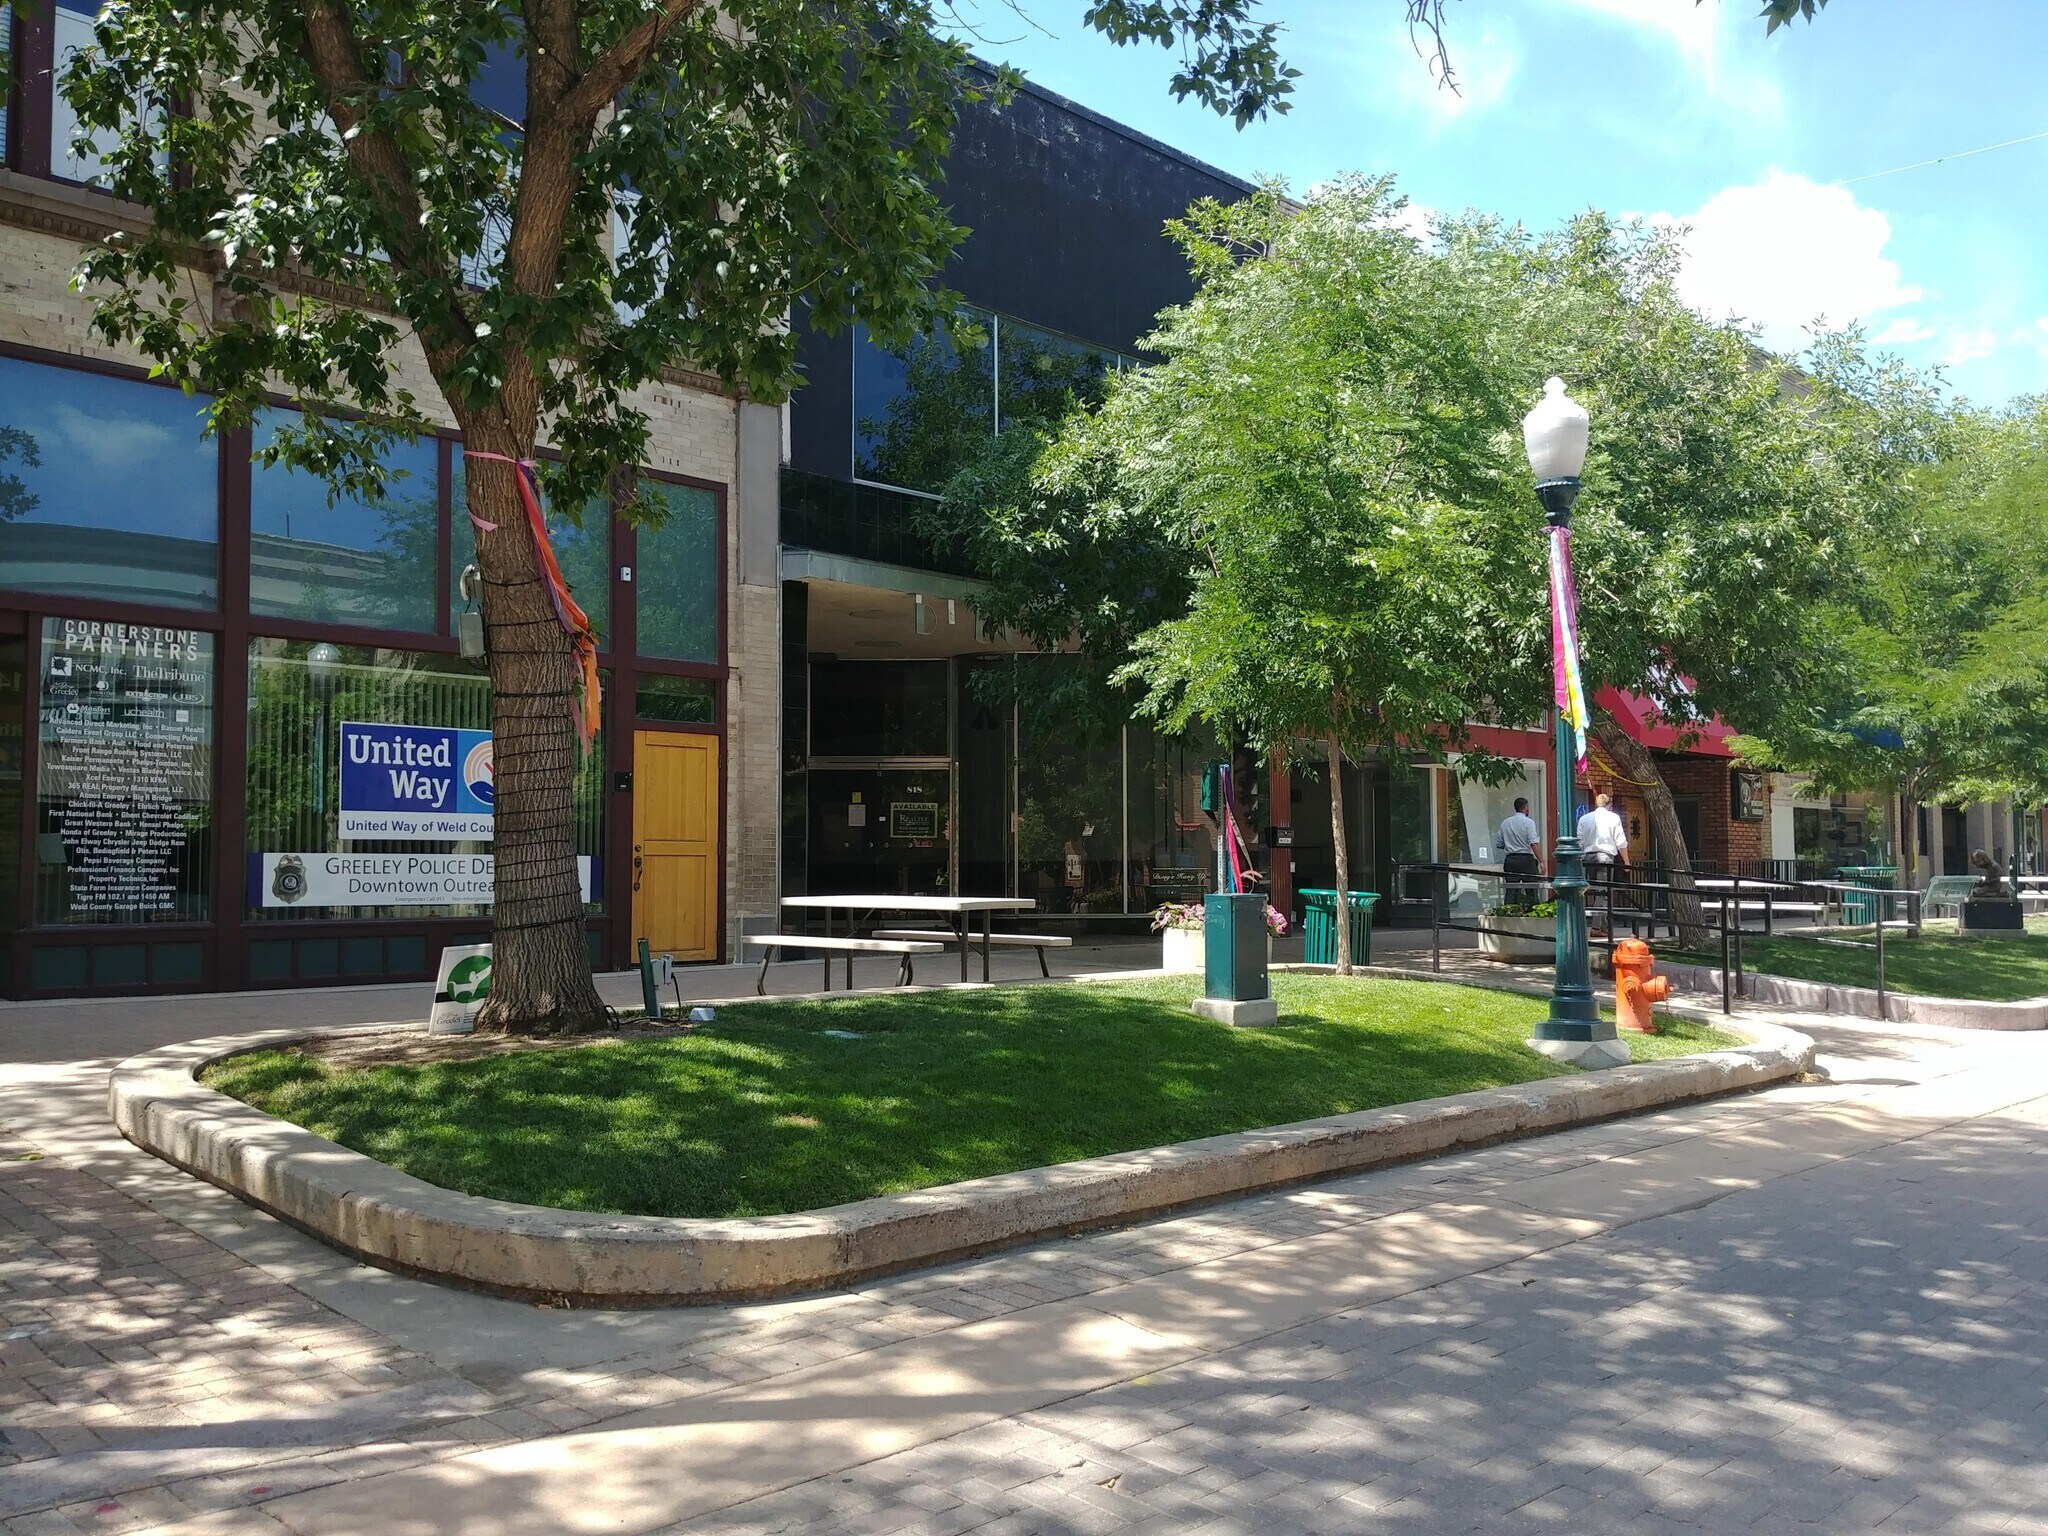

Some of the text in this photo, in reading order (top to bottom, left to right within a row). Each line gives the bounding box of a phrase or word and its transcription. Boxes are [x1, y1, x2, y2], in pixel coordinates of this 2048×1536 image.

[65, 620, 197, 644] CORNERSTONE
[65, 634, 197, 661] PARTNERS
[76, 664, 107, 675] NCMC,
[126, 688, 168, 701] EXTRACTION
[124, 708, 164, 717] uchealth
[50, 718, 83, 727] Advanced
[104, 730, 123, 738] Group
[145, 733, 180, 741] Connecting
[93, 748, 112, 756] Range
[114, 749, 138, 757] Roofing
[348, 734, 451, 767] United
[47, 763, 87, 772] Townsquare
[102, 775, 124, 783] Energy
[102, 784, 129, 792] Property
[389, 770, 450, 808] Way
[105, 802, 130, 810] Greeley
[162, 804, 182, 812] Toyota
[346, 820, 493, 834] United Way of Weld Cou
[92, 829, 117, 837] Greeley
[81, 838, 101, 847] Elway
[103, 838, 130, 847] Chrysler
[132, 839, 148, 848] Jeep
[84, 857, 102, 865] Pepsi
[136, 857, 165, 865] Company
[326, 858, 493, 874] GREELEY POLICE DE
[350, 879, 494, 893] Downtown Outrea
[76, 894, 93, 902] Tigre
[114, 903, 137, 911] Garage
